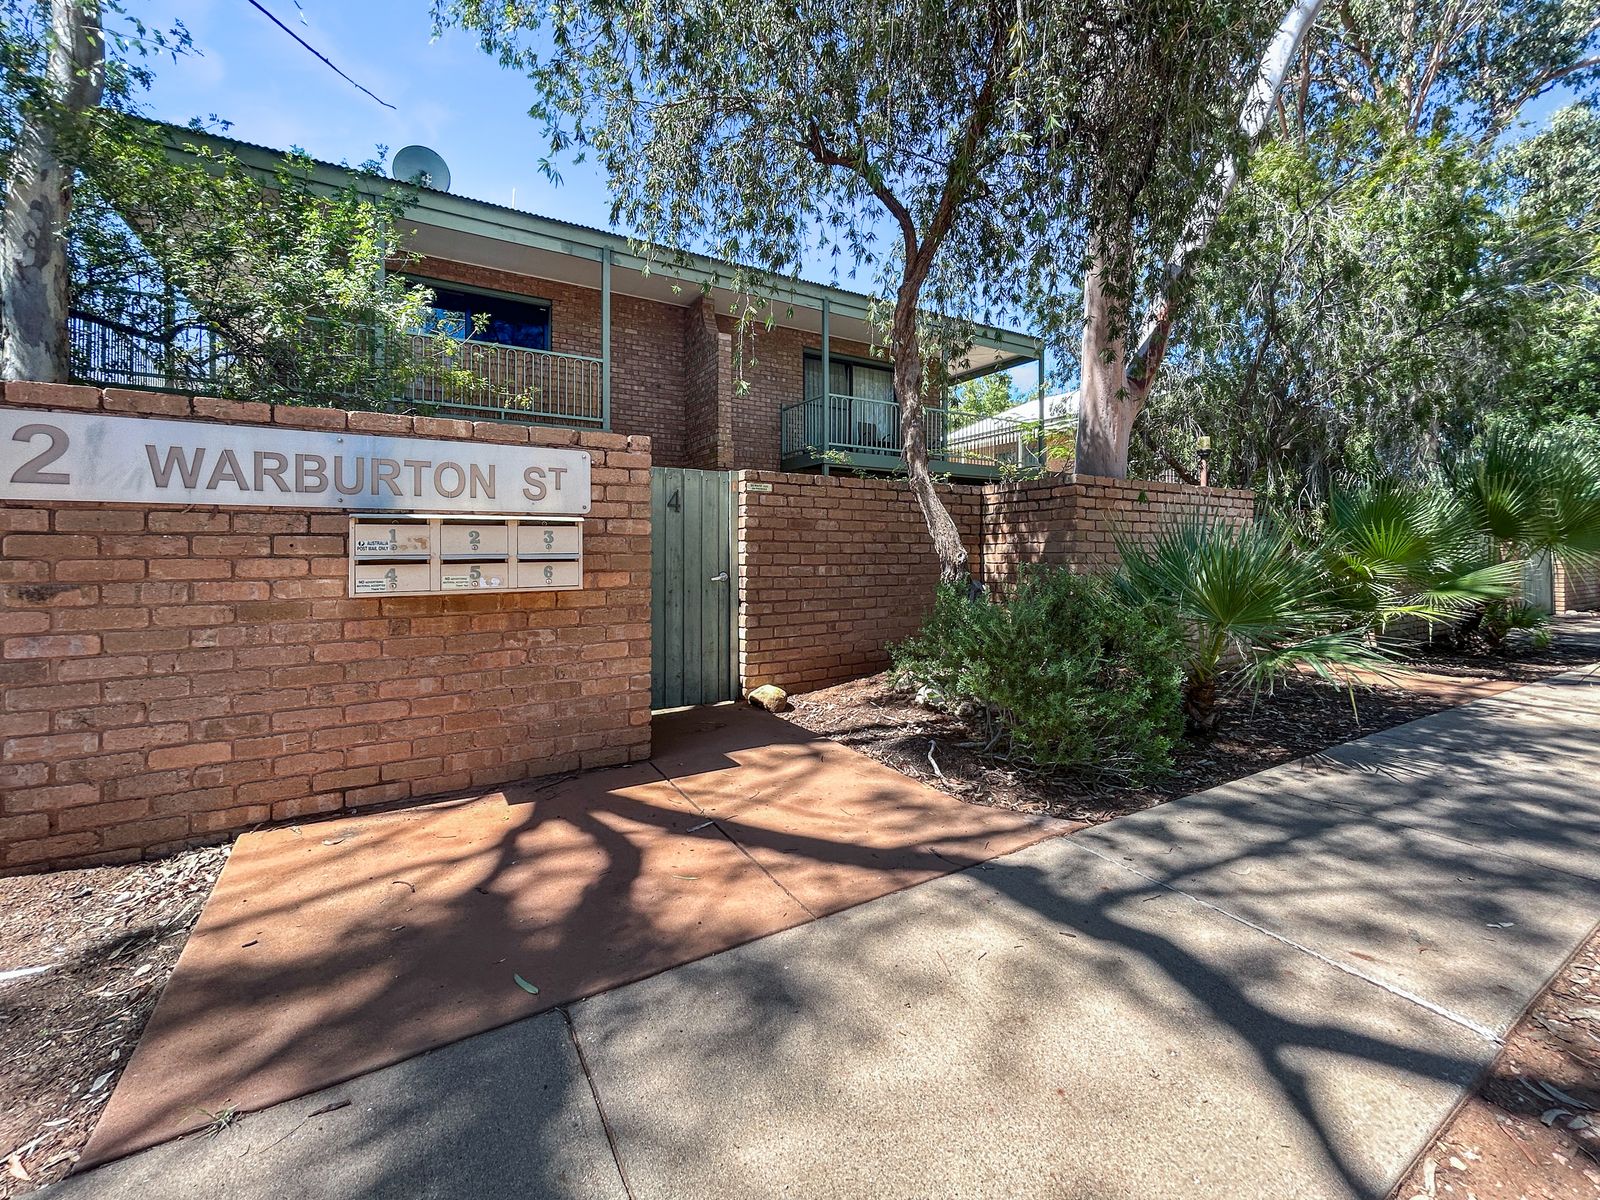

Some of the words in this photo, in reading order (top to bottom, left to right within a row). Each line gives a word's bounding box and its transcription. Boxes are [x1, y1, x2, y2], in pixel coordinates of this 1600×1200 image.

[10, 423, 70, 485] 2
[145, 444, 496, 499] WARBURTON
[522, 466, 568, 501] ST
[667, 489, 681, 513] 4
[389, 529, 397, 543] 1
[469, 530, 480, 544] 2
[543, 530, 554, 544] 3
[385, 568, 397, 582] 4
[470, 565, 481, 580] 5
[543, 565, 553, 578] 6
